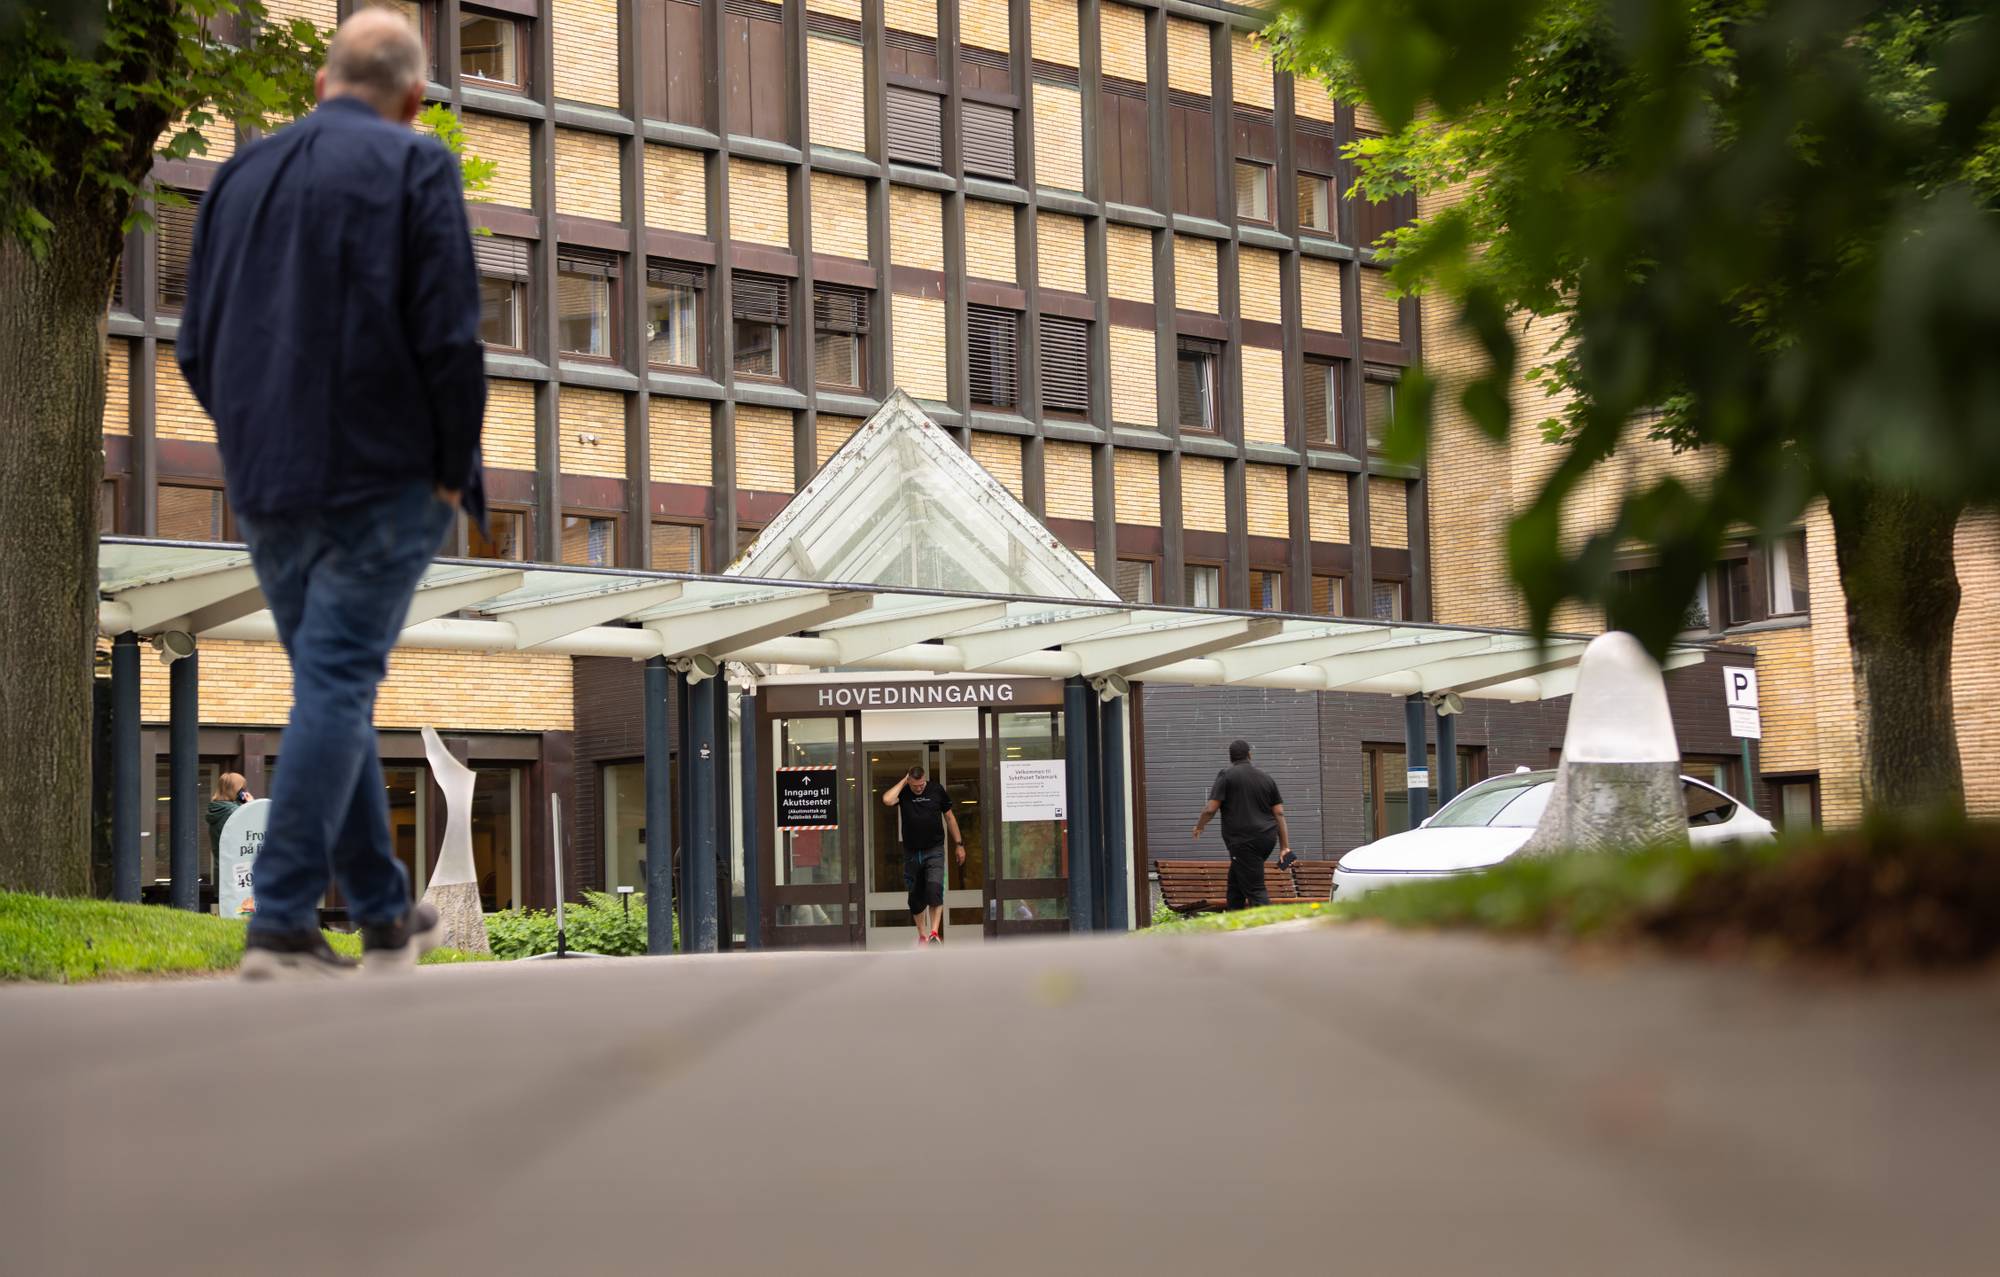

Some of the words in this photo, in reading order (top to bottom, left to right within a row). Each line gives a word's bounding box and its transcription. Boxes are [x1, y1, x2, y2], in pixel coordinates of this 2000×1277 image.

[818, 684, 1013, 706] HOVEDINNGANG
[1733, 672, 1748, 701] P
[784, 788, 819, 797] Inngang
[820, 787, 829, 795] til
[240, 843, 254, 857] på
